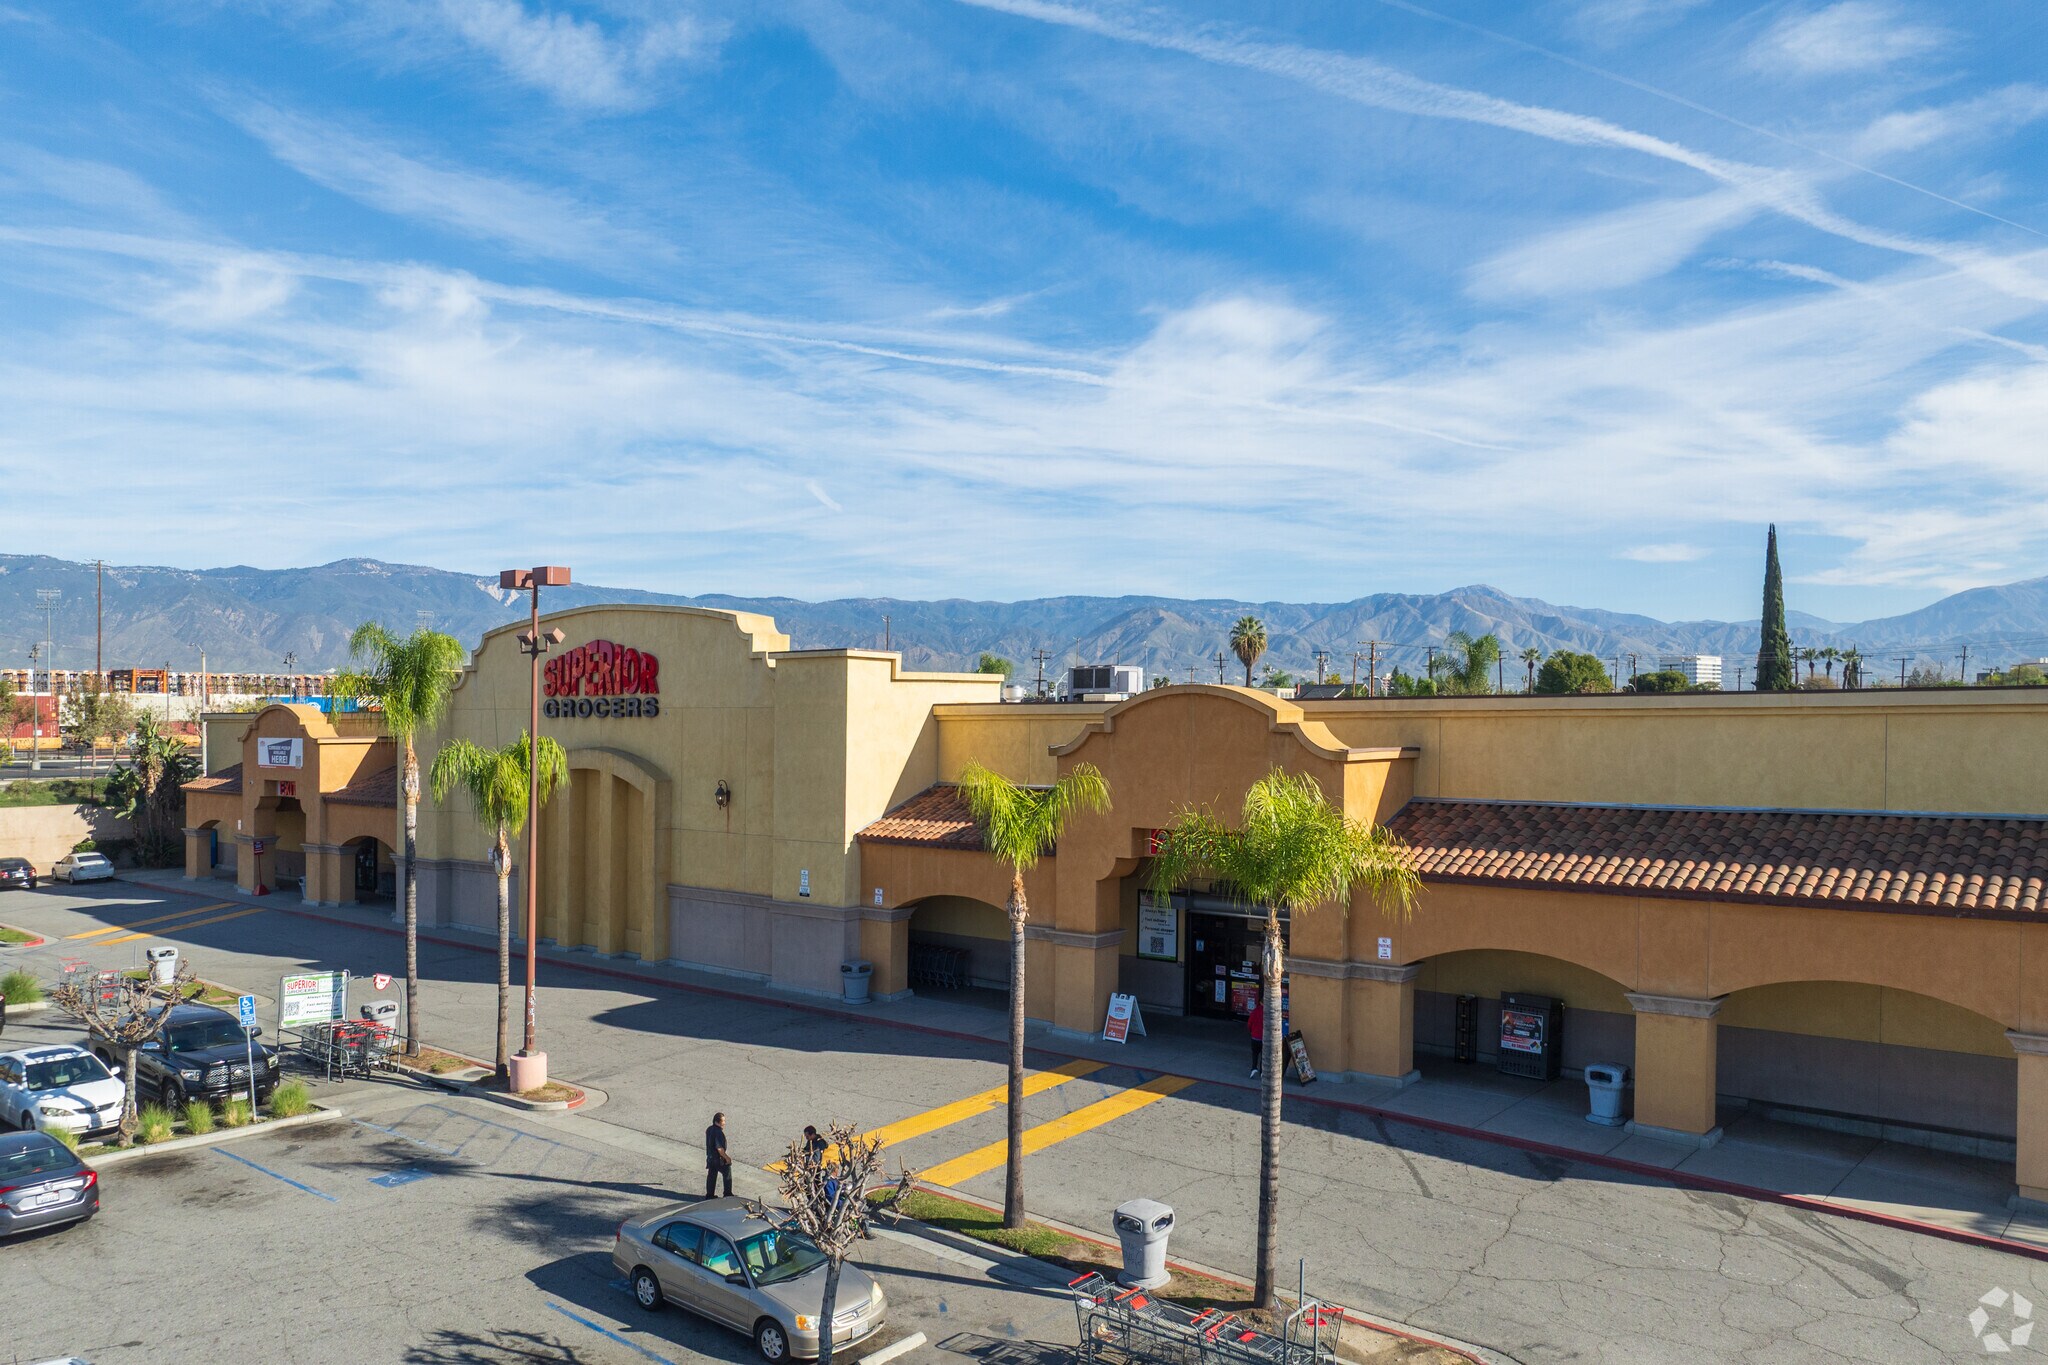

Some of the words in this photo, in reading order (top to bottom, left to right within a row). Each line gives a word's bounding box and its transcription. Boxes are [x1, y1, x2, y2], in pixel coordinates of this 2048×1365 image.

[543, 640, 659, 697] SUPERIOR
[543, 697, 659, 718] GROCERS
[271, 755, 288, 764] HERE!
[280, 781, 296, 796] EXIT
[286, 980, 316, 990] SUPERIOR
